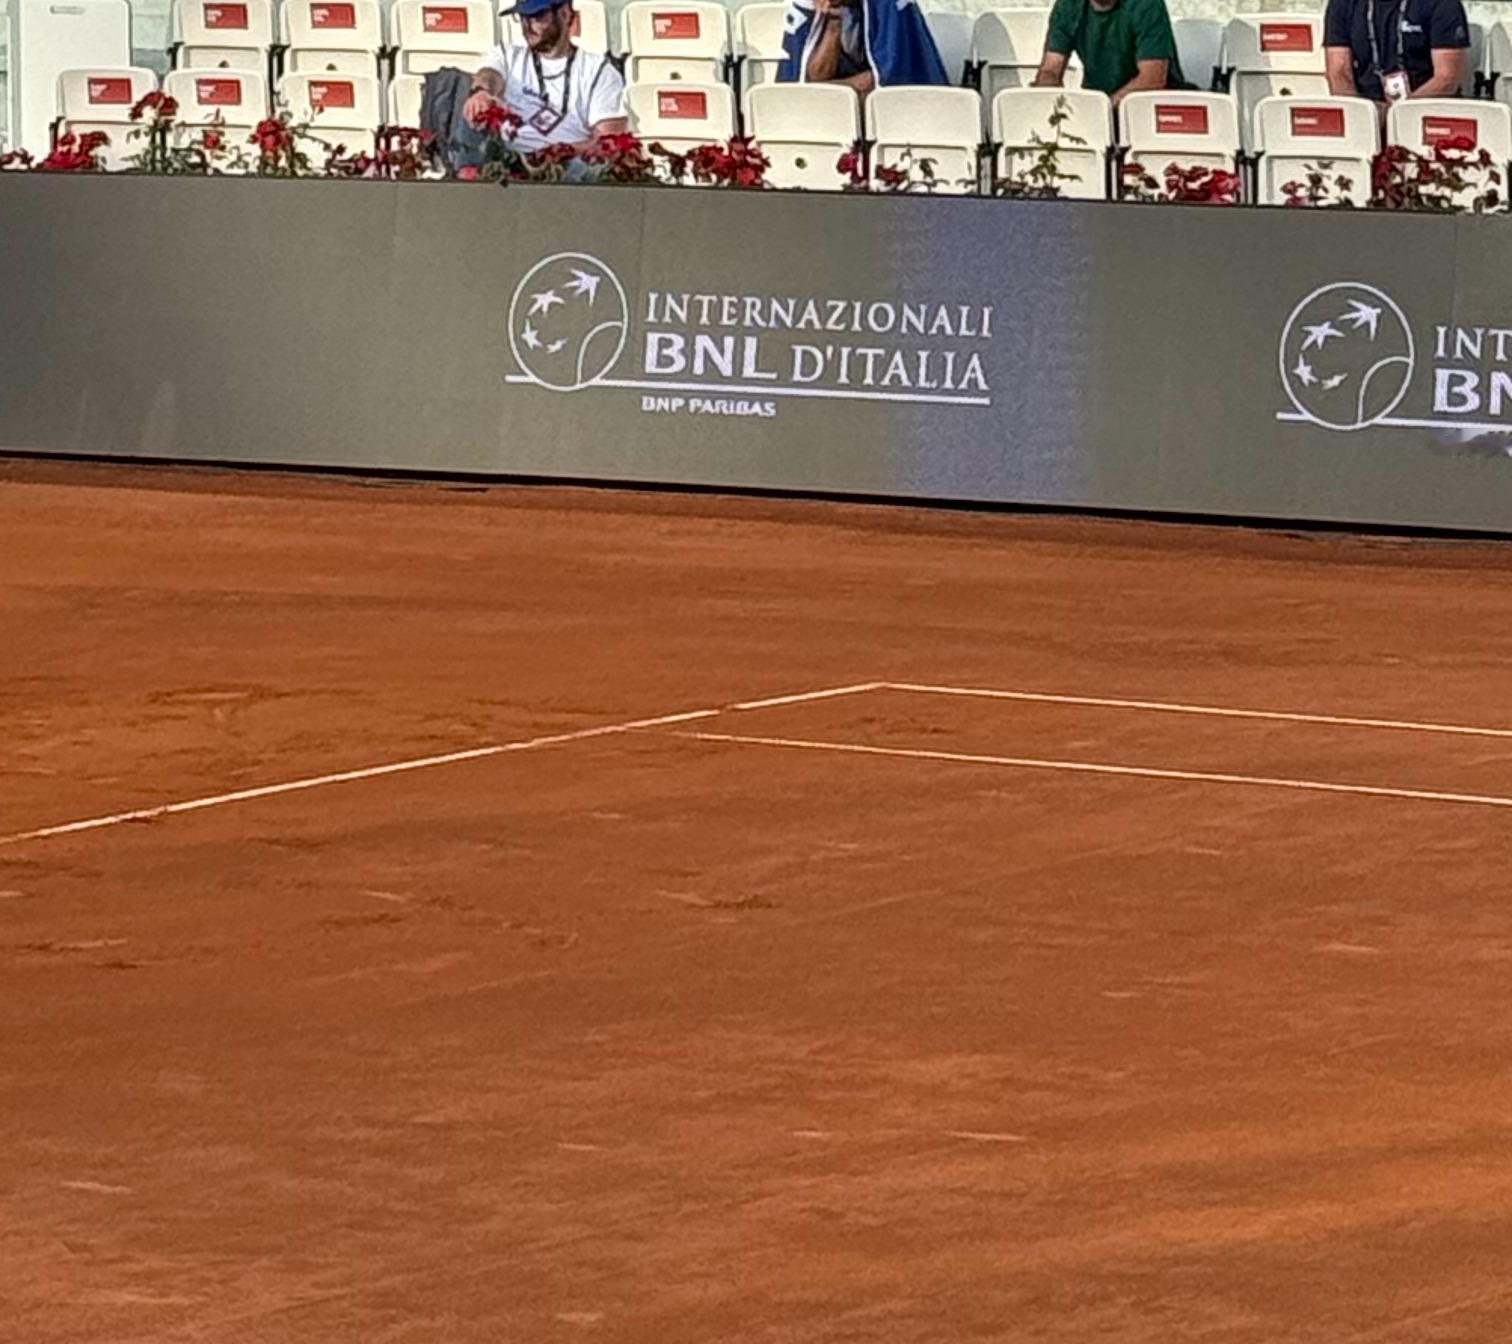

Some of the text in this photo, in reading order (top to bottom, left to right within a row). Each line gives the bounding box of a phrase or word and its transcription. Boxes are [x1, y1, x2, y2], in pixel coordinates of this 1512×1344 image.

[645, 292, 992, 338] INTERNAZIONALI
[644, 332, 989, 390] BNL D'ITALIA
[641, 395, 685, 412] BNP
